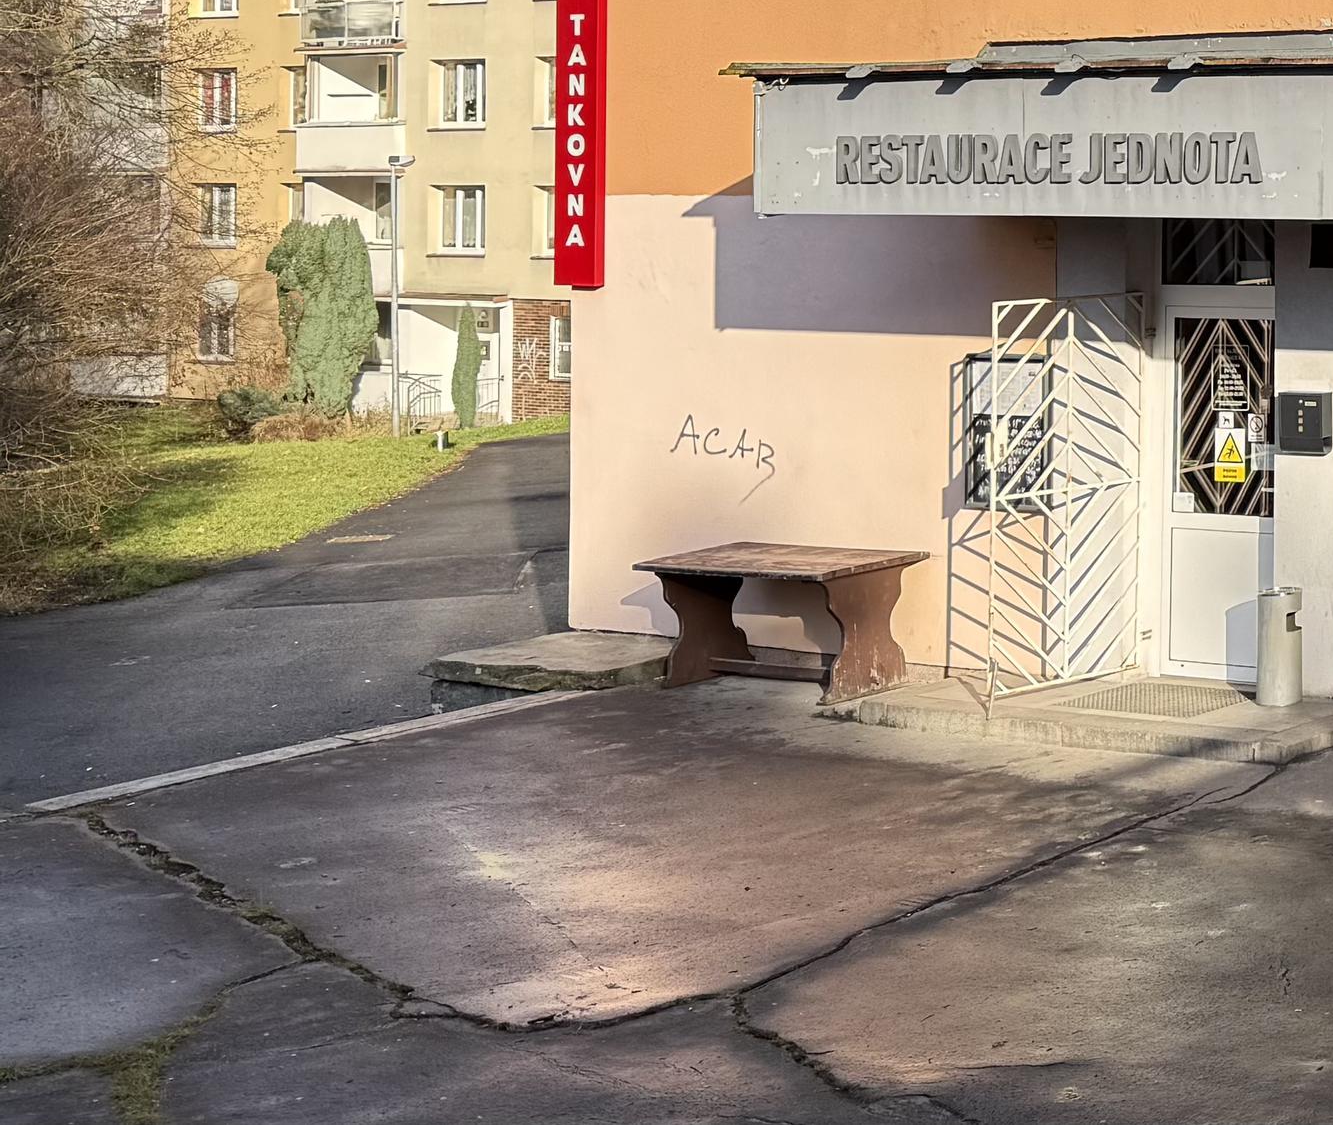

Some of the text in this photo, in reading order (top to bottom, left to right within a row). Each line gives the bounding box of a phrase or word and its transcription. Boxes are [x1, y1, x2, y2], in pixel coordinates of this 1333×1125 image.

[565, 13, 587, 247] TANKOVNA
[835, 131, 1263, 185] RESTAURACE JEDNOTA
[670, 414, 775, 505] ACAB
